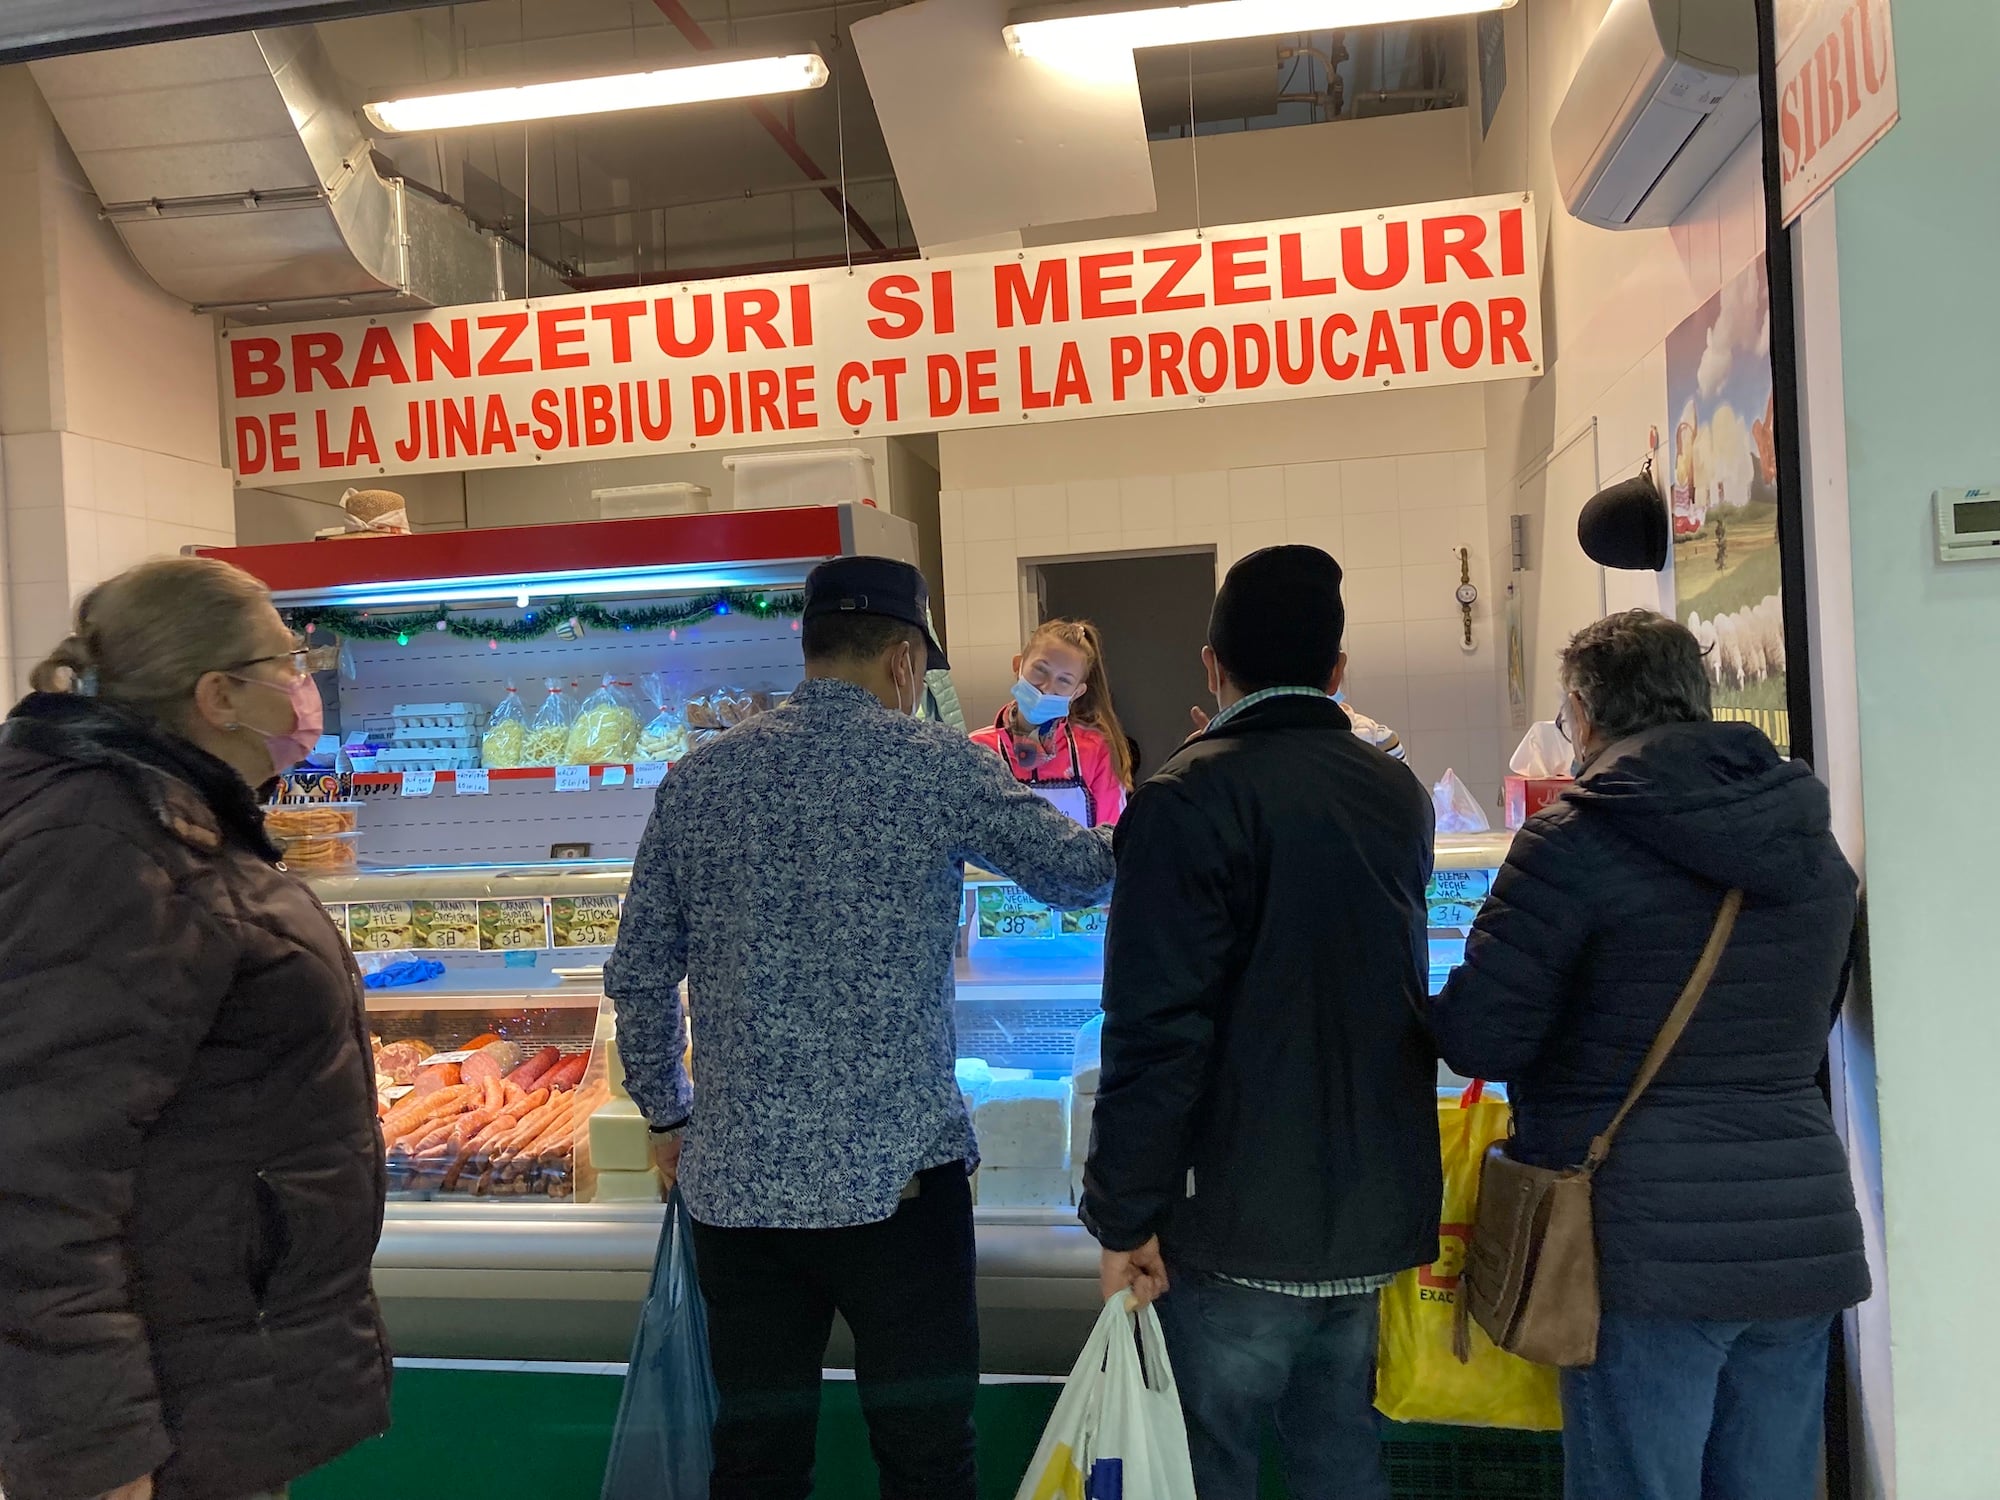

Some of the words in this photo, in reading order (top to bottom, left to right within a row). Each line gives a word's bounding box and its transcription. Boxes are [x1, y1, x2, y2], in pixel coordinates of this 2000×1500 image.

[1781, 0, 1888, 187] SIBIU
[231, 284, 813, 398] BRANZETURI
[868, 271, 954, 339] SI
[994, 209, 1525, 328] MEZELURI
[235, 412, 300, 475] DE
[315, 406, 380, 468] LA
[395, 379, 672, 462] JINA-SIBIU
[927, 350, 1000, 418] DE
[1019, 342, 1092, 409] LA
[1110, 297, 1532, 400] PRODUCATOR
[1437, 905, 1462, 921] 34
[1003, 915, 1025, 934] 38
[370, 930, 391, 948] 43
[436, 931, 456, 946] 38
[575, 925, 597, 945] 39
[1420, 1289, 1454, 1303] EXAC
